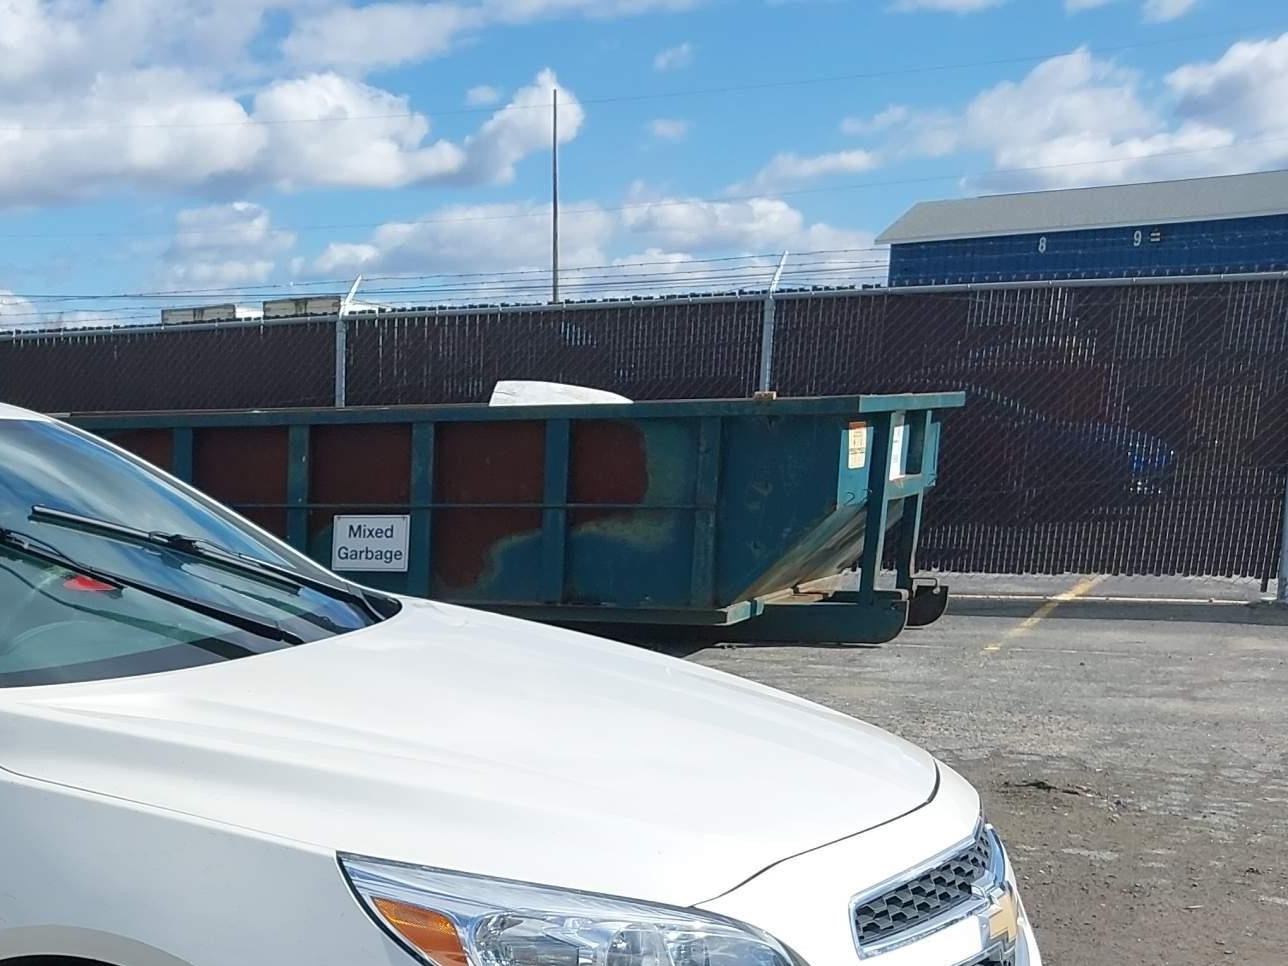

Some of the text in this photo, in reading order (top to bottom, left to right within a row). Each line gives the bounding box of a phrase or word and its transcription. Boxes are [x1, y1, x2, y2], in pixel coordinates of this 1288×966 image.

[1038, 236, 1047, 253] 8
[1133, 230, 1142, 247] 9
[348, 524, 394, 539] Mixed
[337, 545, 403, 564] Garbage
